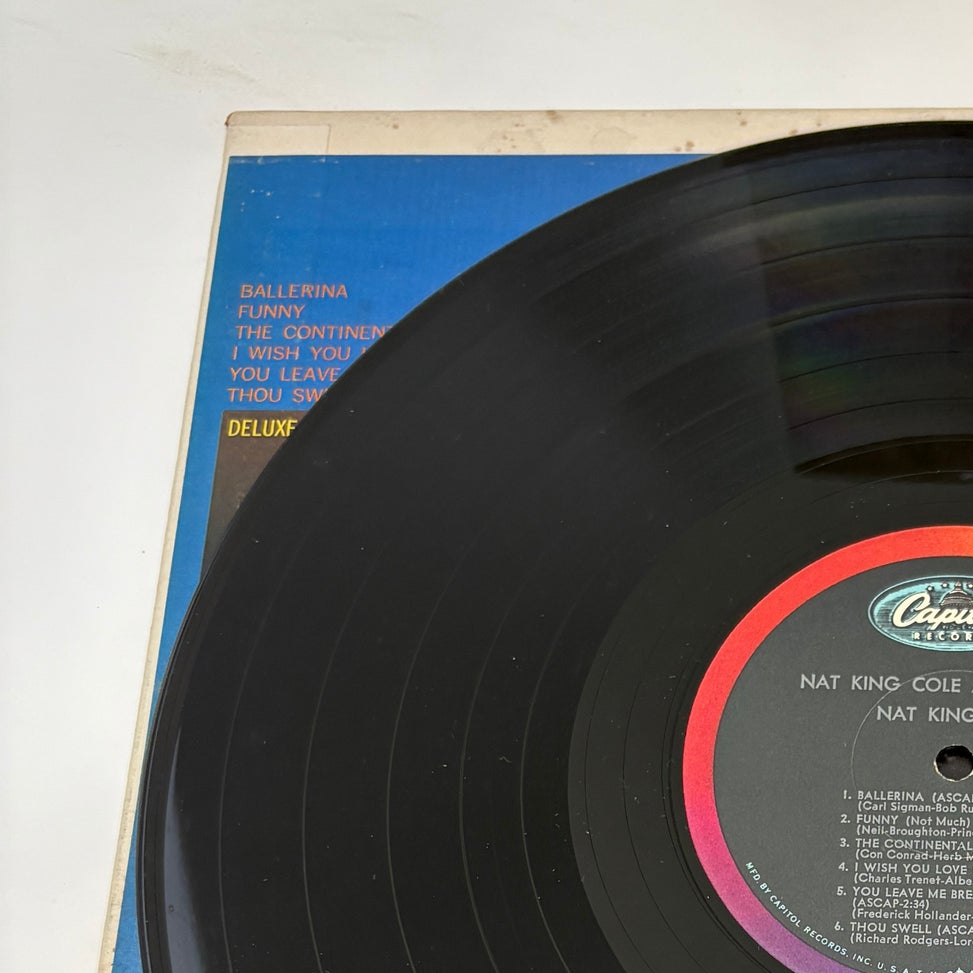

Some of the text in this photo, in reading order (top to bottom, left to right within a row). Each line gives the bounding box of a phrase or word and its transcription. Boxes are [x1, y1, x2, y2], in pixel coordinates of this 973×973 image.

[240, 284, 348, 299] BALLERINA
[238, 304, 305, 319] FUNNY
[235, 325, 272, 340] THE
[231, 346, 238, 360] I
[249, 346, 299, 361] WISH
[310, 346, 351, 361] YOU
[229, 366, 341, 382] YOU LEAVE
[227, 387, 282, 403] THOU
[800, 674, 841, 690] NAT
[851, 675, 901, 691] KING
[912, 677, 961, 693] COLE
[876, 705, 917, 722] NAT
[843, 790, 852, 800] 1.
[857, 790, 925, 802] BALLERINA
[858, 802, 887, 813] (Carl
[890, 803, 957, 814] Sigman-Bob
[840, 814, 851, 824] 2.
[856, 814, 899, 825] FUNNY
[906, 816, 933, 827] (Not
[936, 816, 971, 828] Much)
[839, 838, 850, 848] 3.
[856, 838, 880, 849] THE
[884, 839, 973, 851] CONTINENTAL
[855, 849, 883, 860] (Con
[886, 850, 962, 862] Conrad-Herb
[838, 862, 849, 872] 4.
[854, 862, 859, 872] I
[864, 863, 898, 874] WISH
[902, 863, 931, 874] YOU
[935, 864, 968, 875] LOVE
[854, 872, 902, 884] (Charles
[836, 886, 847, 896] 5.
[853, 886, 880, 898] YOU
[885, 887, 924, 899] LEAVE
[927, 888, 947, 899] ME
[852, 898, 930, 910] (ASCAP-2:34)
[745, 861, 761, 884] MFD.
[759, 882, 772, 894] BY
[769, 895, 801, 928] CAPITOL
[852, 953, 873, 966] INC.
[852, 908, 910, 921] (Frederick
[834, 922, 844, 932] 6.
[850, 922, 887, 933] THOU
[891, 923, 932, 934] SWELL
[850, 933, 899, 945] (Richard
